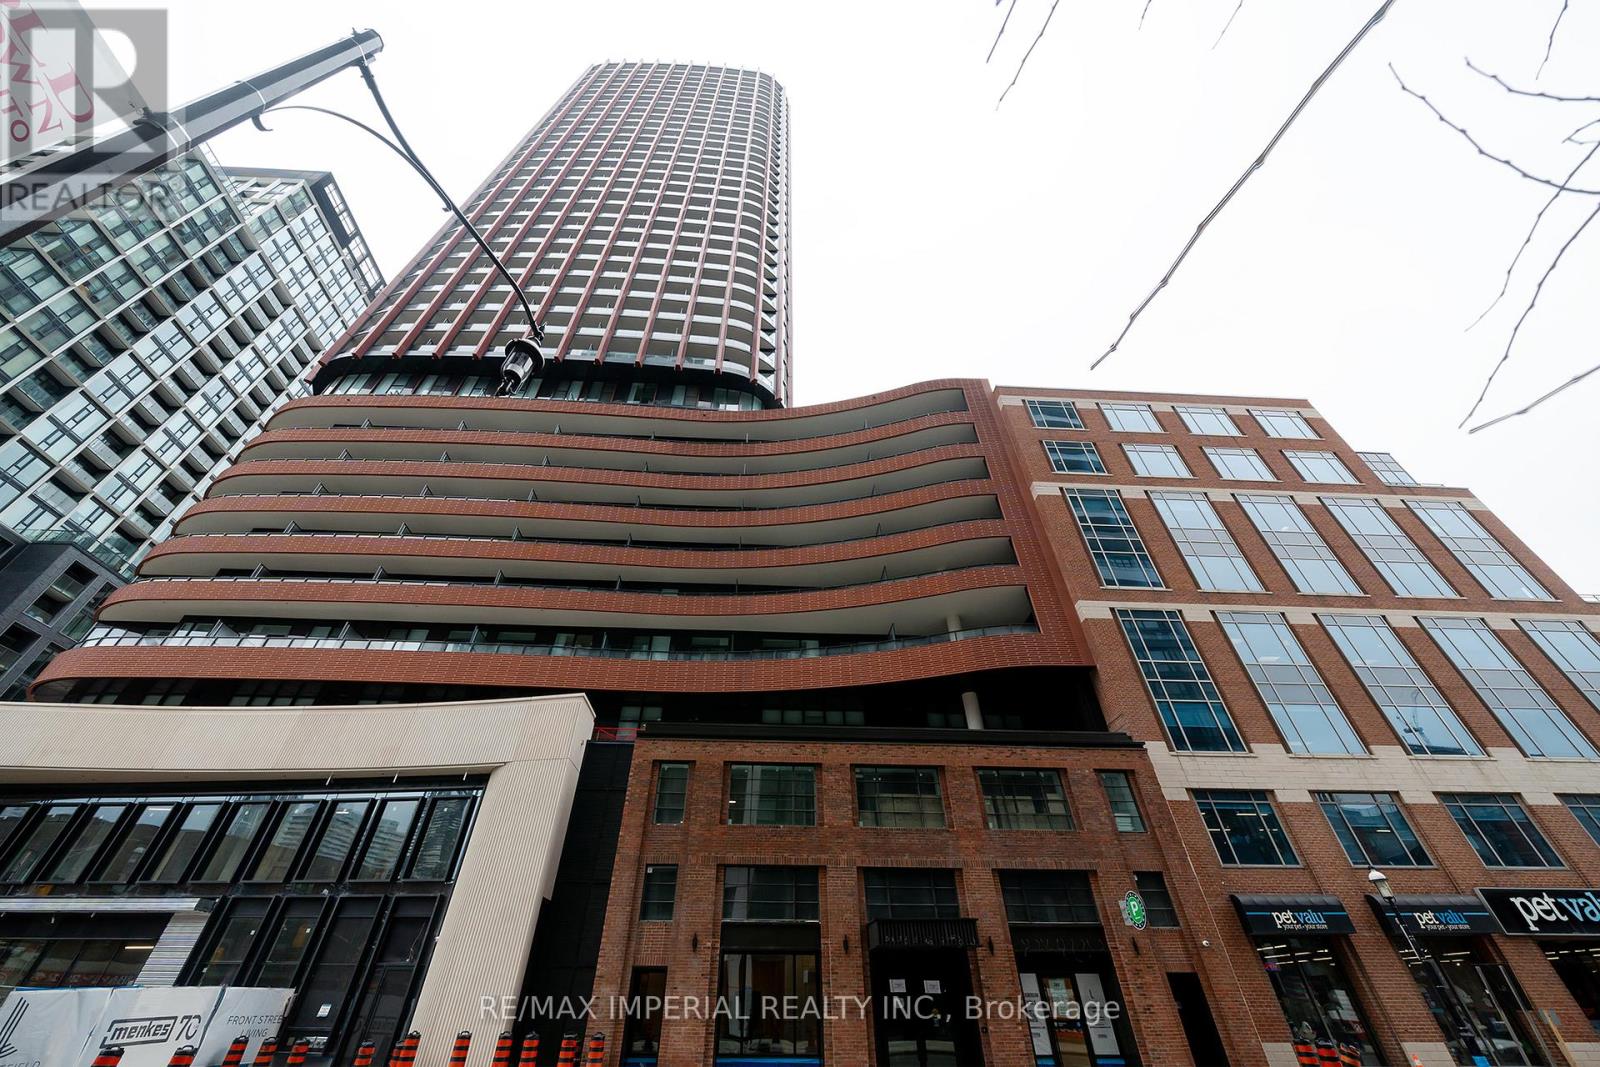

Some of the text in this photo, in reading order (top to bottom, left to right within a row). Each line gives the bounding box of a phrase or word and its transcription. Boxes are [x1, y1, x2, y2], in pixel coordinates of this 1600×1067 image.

[1271, 909, 1326, 929] pet valu
[1413, 909, 1468, 929] pet valu
[1509, 892, 1600, 931] pet val
[227, 1015, 257, 1025] FRONT
[110, 1020, 171, 1041] menkes
[240, 1028, 269, 1038] LIVING
